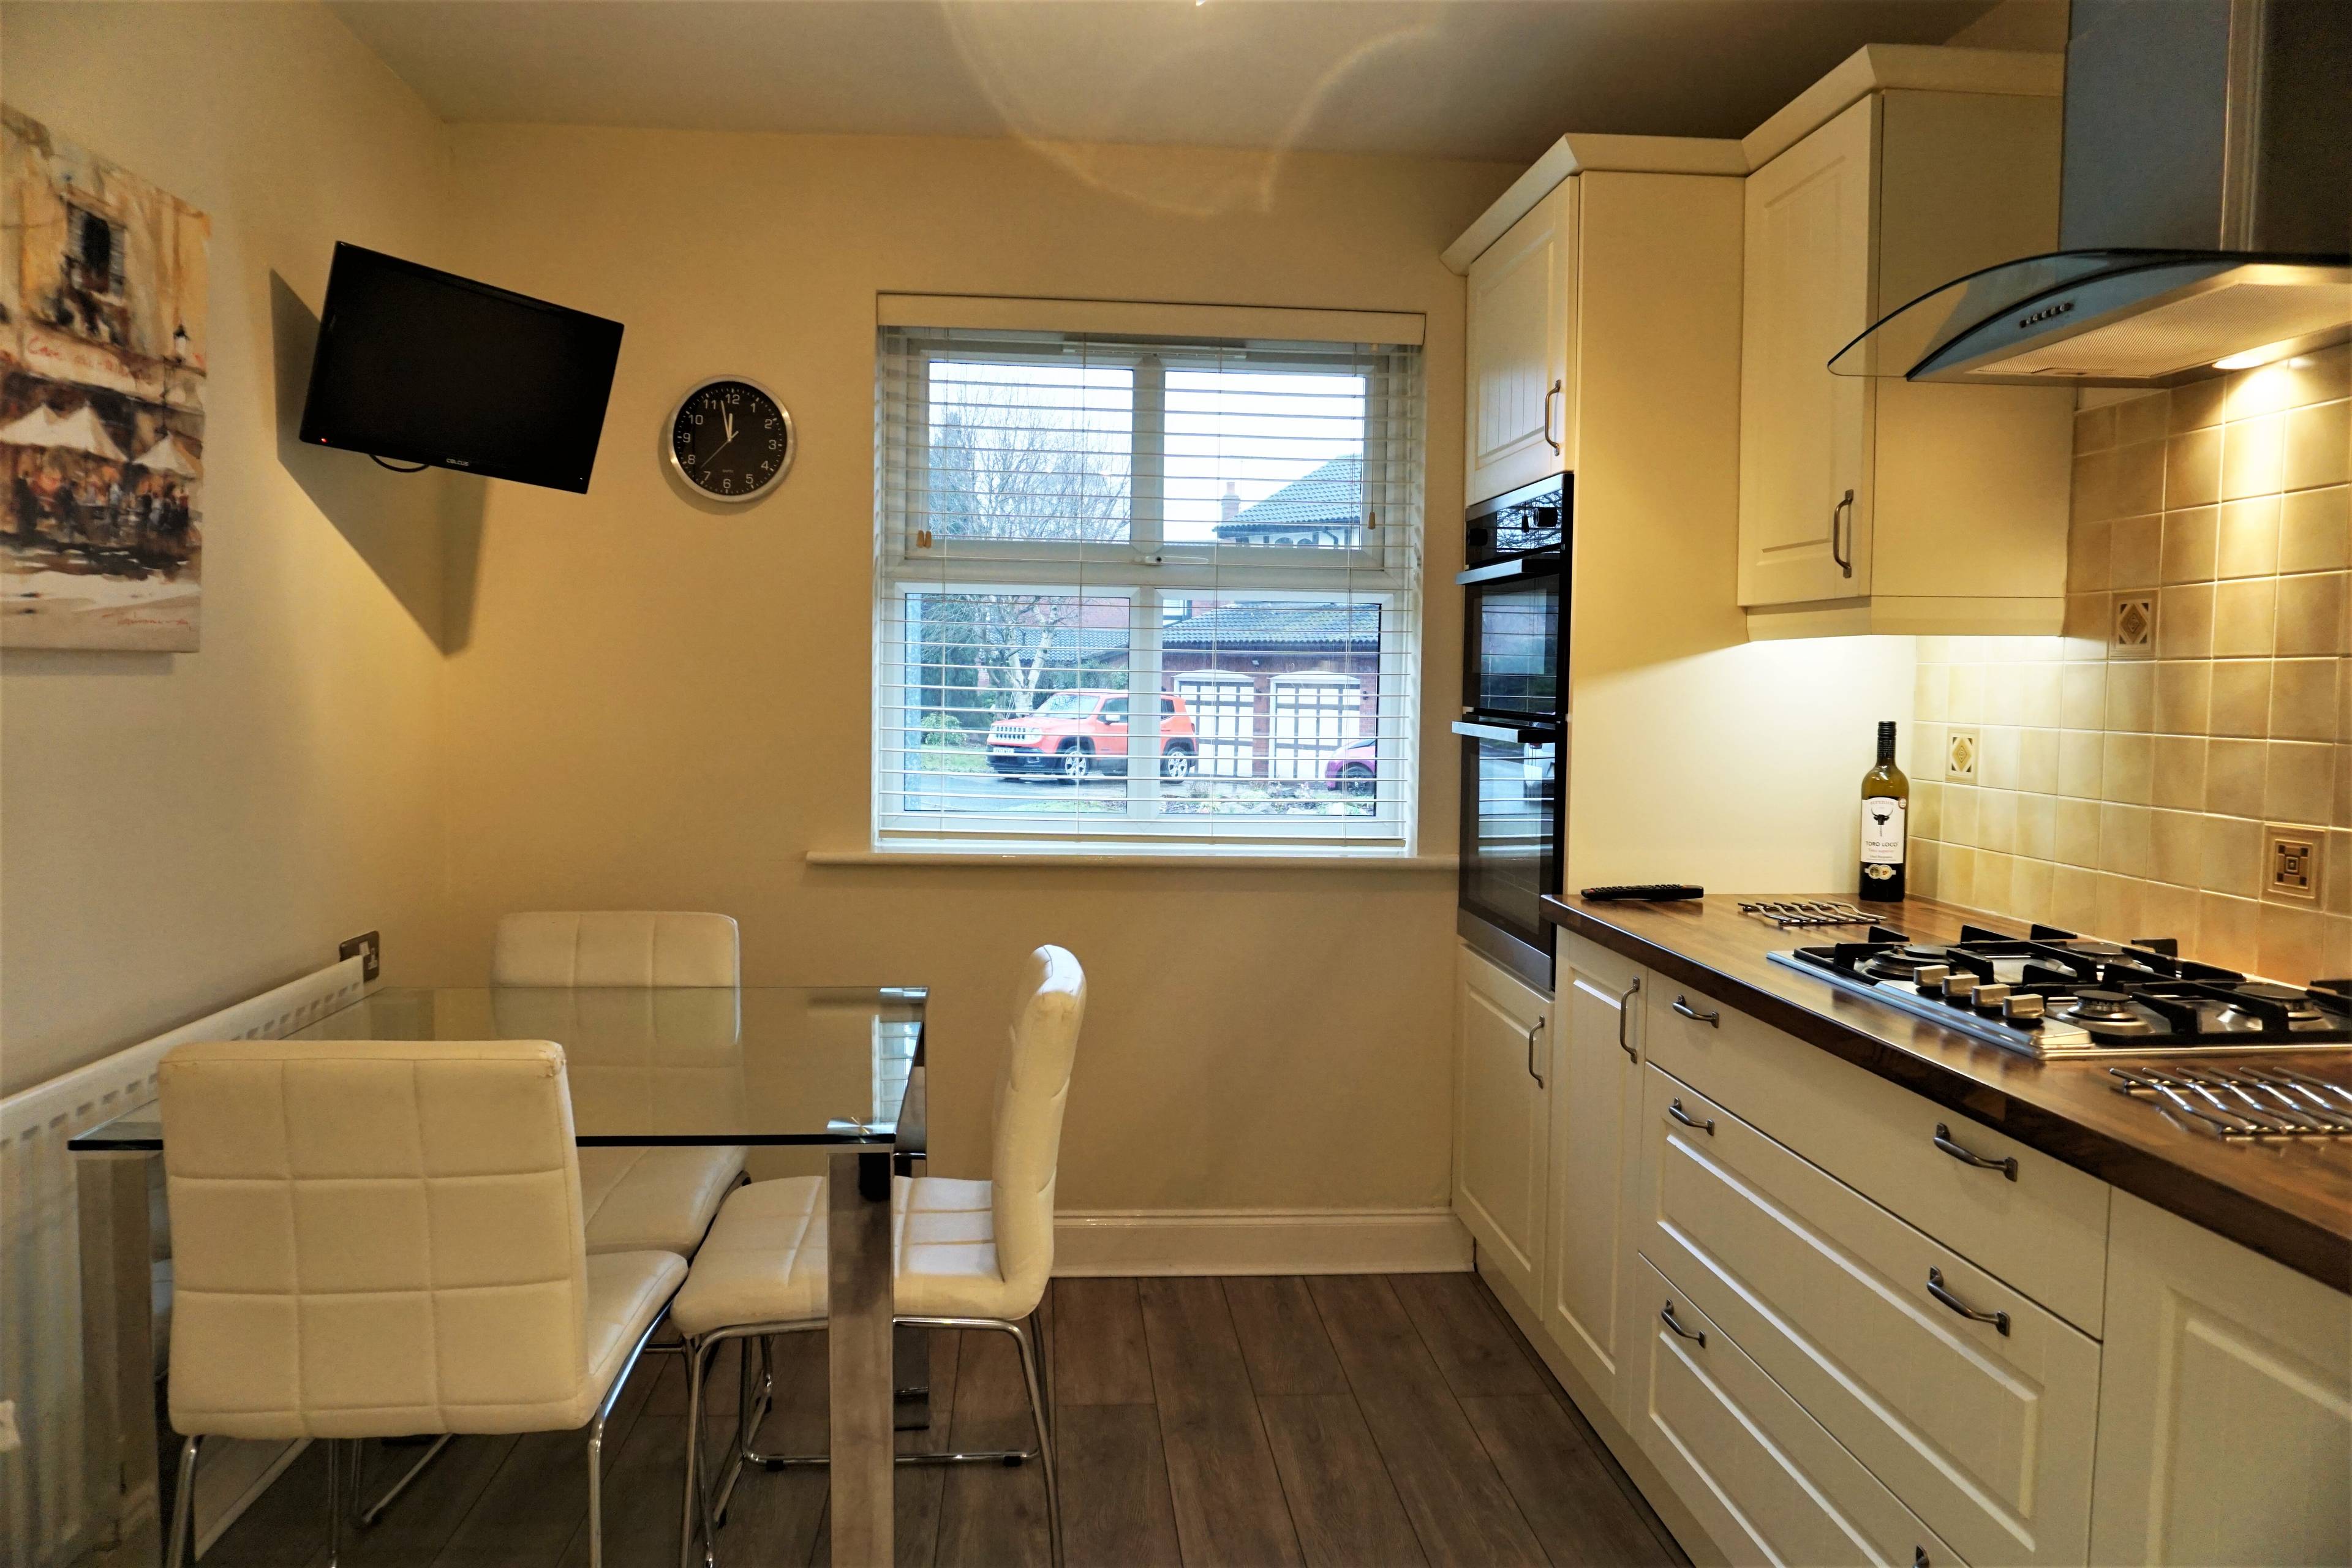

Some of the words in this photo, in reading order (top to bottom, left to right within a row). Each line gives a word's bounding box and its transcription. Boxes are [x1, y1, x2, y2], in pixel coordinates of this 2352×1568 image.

[704, 399, 716, 409] 11
[726, 394, 740, 404] 12
[750, 403, 756, 413] 1
[689, 415, 703, 425] 10
[764, 419, 772, 429] 2
[683, 433, 690, 443] 9
[769, 440, 776, 450] 3
[688, 454, 696, 464] 8
[761, 461, 769, 470] 4
[704, 471, 711, 481] 7
[746, 474, 753, 484] 5
[723, 479, 731, 489] 6
